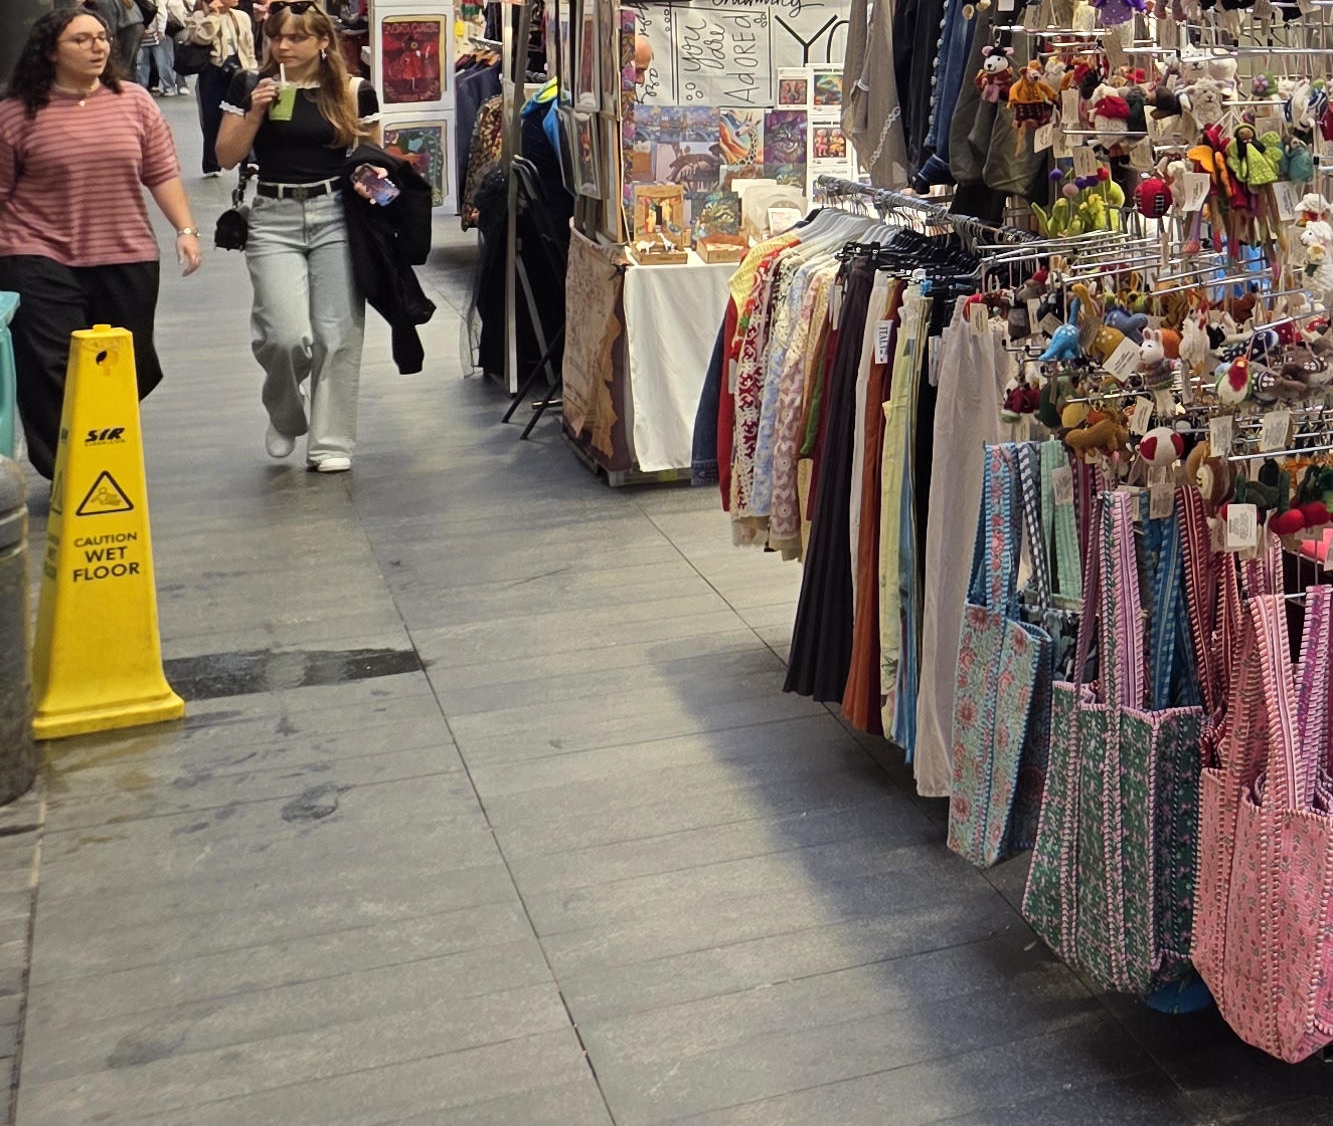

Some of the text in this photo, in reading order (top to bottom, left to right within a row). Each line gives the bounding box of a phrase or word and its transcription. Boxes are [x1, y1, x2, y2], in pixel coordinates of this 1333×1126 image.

[74, 531, 137, 547] CAUTION
[85, 546, 127, 563] WET
[73, 562, 139, 582] FLOOR
